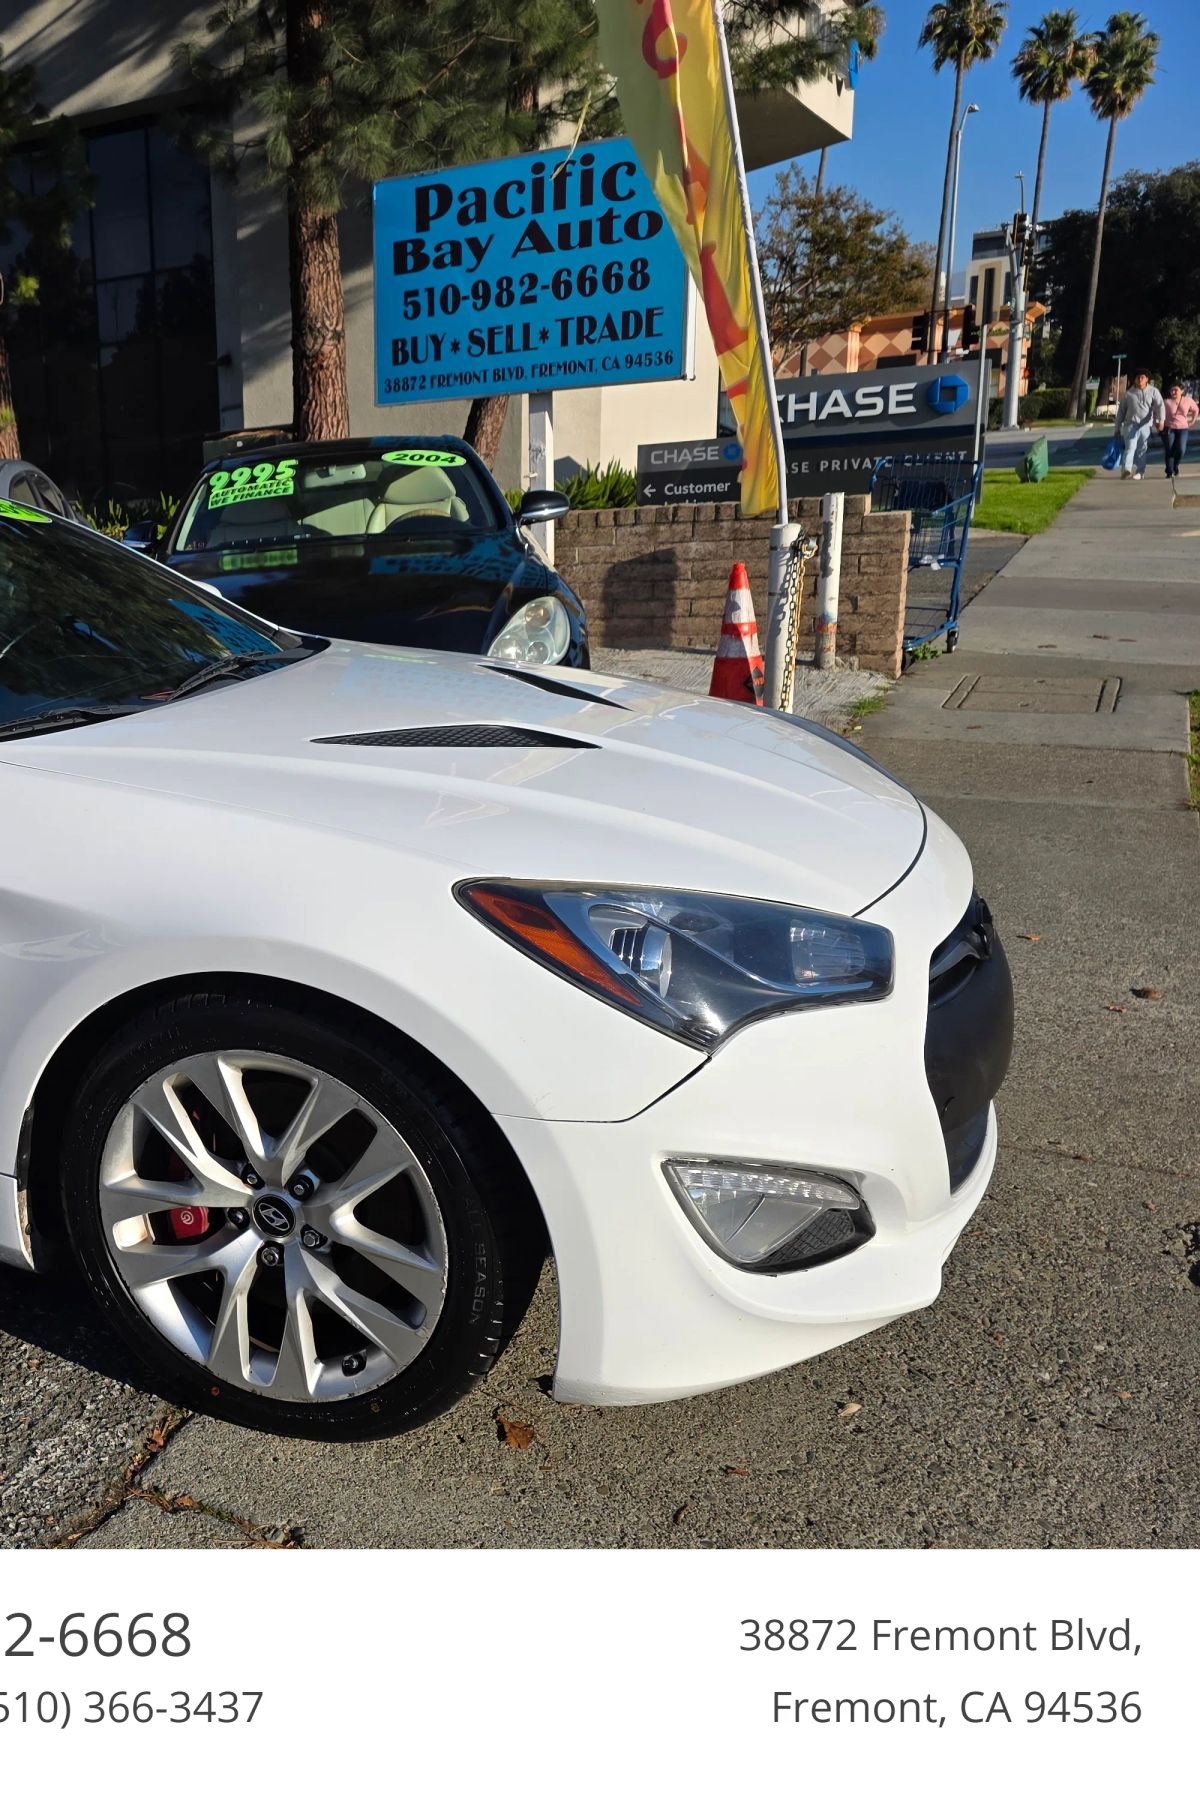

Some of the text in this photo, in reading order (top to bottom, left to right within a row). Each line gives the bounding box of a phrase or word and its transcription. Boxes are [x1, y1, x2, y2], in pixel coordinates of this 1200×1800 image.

[414, 153, 637, 233] Pacific
[393, 207, 663, 276] Bay Auto
[403, 257, 650, 321] 510-982-6668
[391, 306, 664, 366] BUY SELL TRADE
[384, 377, 426, 394] 38872
[430, 369, 488, 389] FREMONT
[602, 355, 620, 371] CA
[625, 351, 674, 369] 94536
[776, 382, 917, 423] HASE
[391, 453, 457, 464] 2004
[650, 446, 720, 465] CHASE
[209, 459, 299, 493] 9995
[212, 480, 290, 499] AUTOMATIC
[233, 487, 291, 502] FINANCE
[664, 482, 731, 496] Customer
